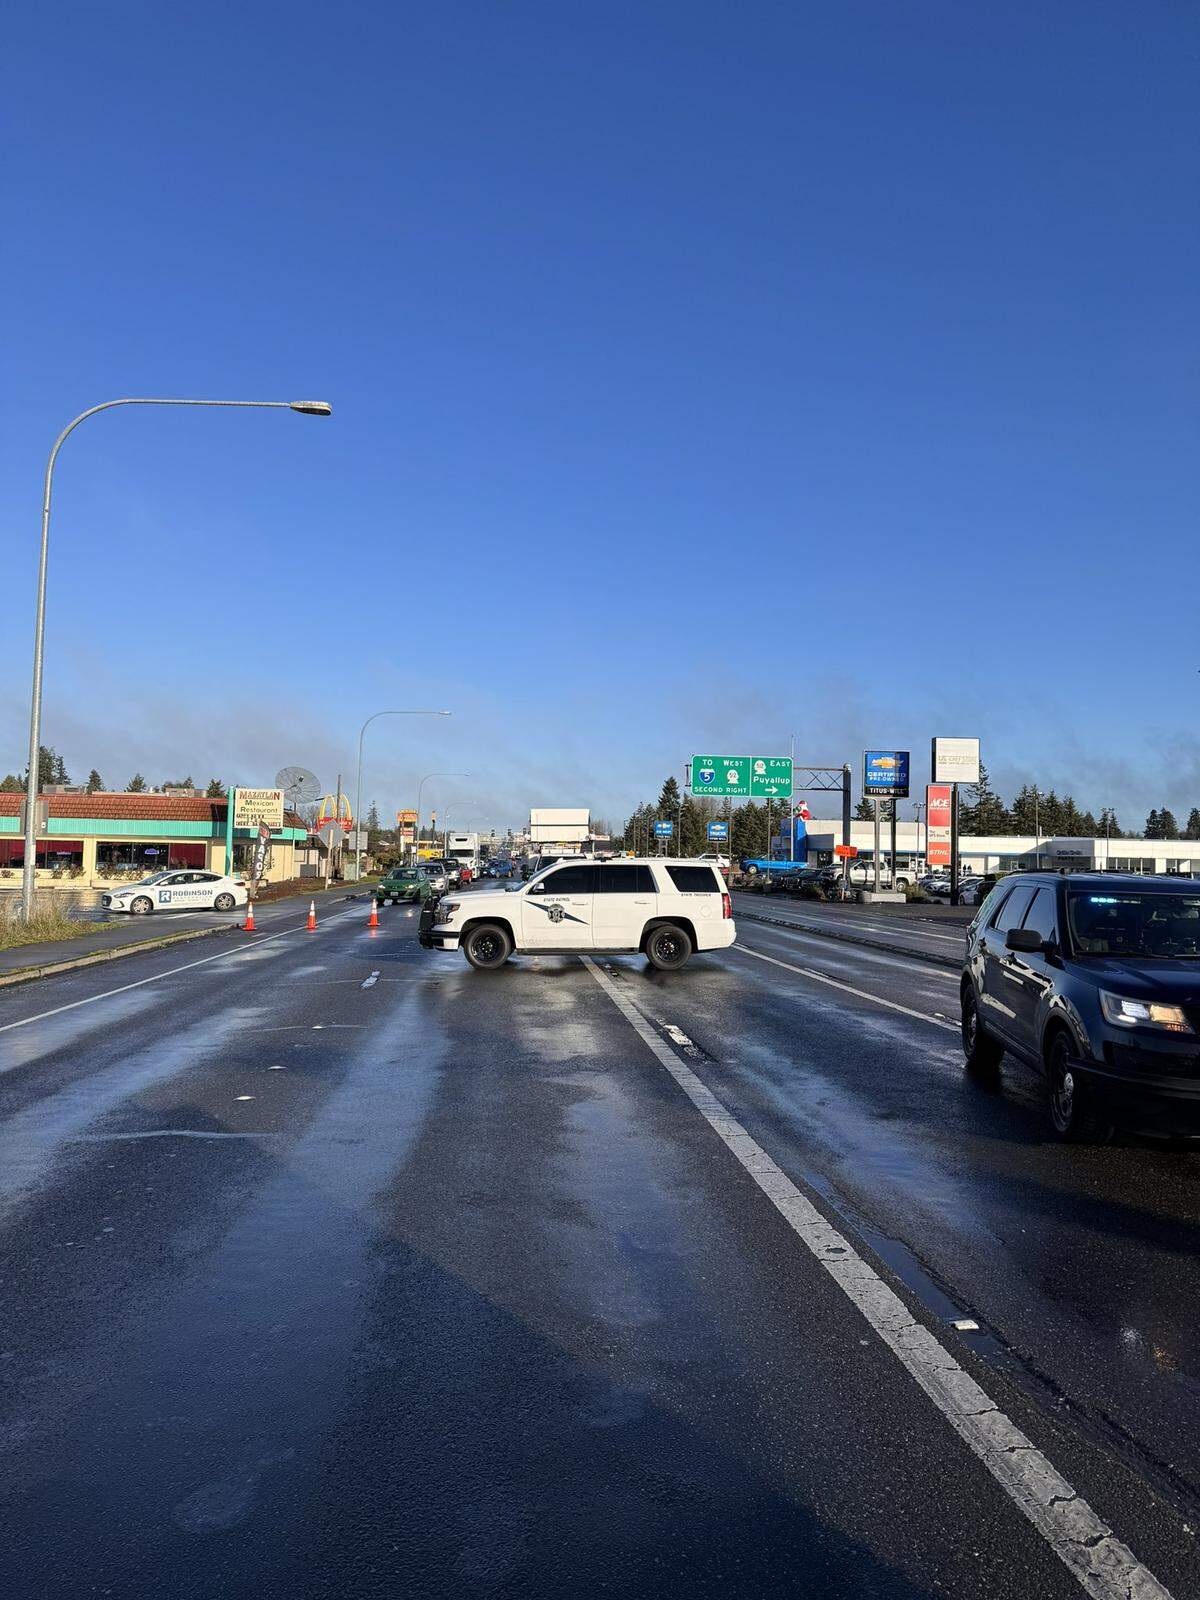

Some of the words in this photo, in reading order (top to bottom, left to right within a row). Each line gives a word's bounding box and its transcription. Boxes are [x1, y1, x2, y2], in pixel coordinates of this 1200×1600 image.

[704, 772, 711, 782] 5
[753, 776, 791, 785] Puyallup
[930, 798, 950, 807] ACE
[172, 889, 213, 897] ROBINSON
